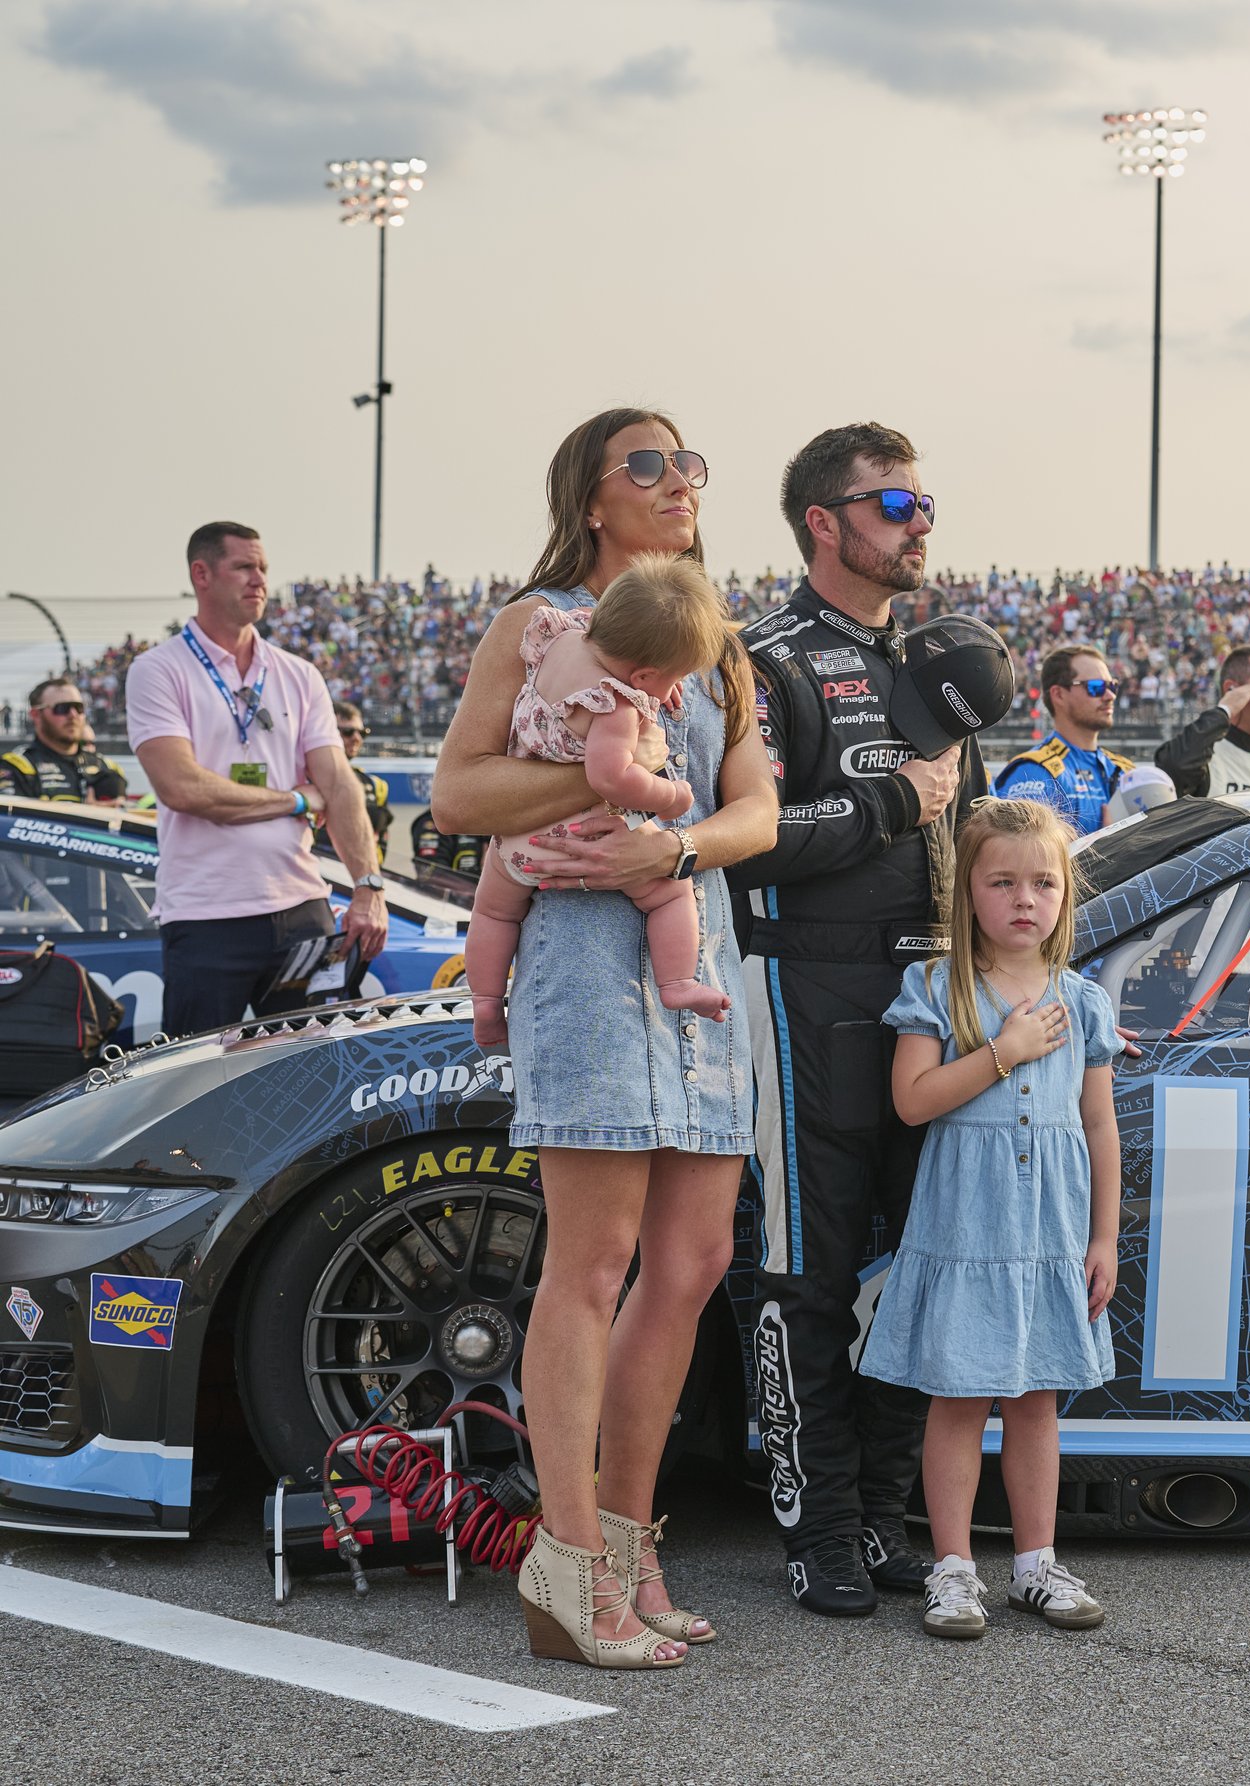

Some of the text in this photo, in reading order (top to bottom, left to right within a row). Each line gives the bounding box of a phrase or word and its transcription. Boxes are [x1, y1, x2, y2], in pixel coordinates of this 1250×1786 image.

[824, 613, 872, 643] FREIGHTLINER
[820, 659, 857, 670] CP SERIES
[822, 650, 851, 661] NASCAR
[822, 679, 871, 699] DEX
[839, 694, 879, 703] imaging
[944, 687, 980, 727] FREIGHTLINER
[832, 711, 886, 726] GOODYEAR
[14, 818, 67, 835] BUILD
[8, 828, 160, 867] SUBMARINES.COM
[898, 938, 937, 950] JOSH
[1120, 1128, 1145, 1161] entral
[381, 1145, 539, 1195] EAGLE
[13, 1300, 34, 1327] 75
[97, 1303, 174, 1324] SUNOCO
[760, 1325, 798, 1503] FREIGHTLINER
